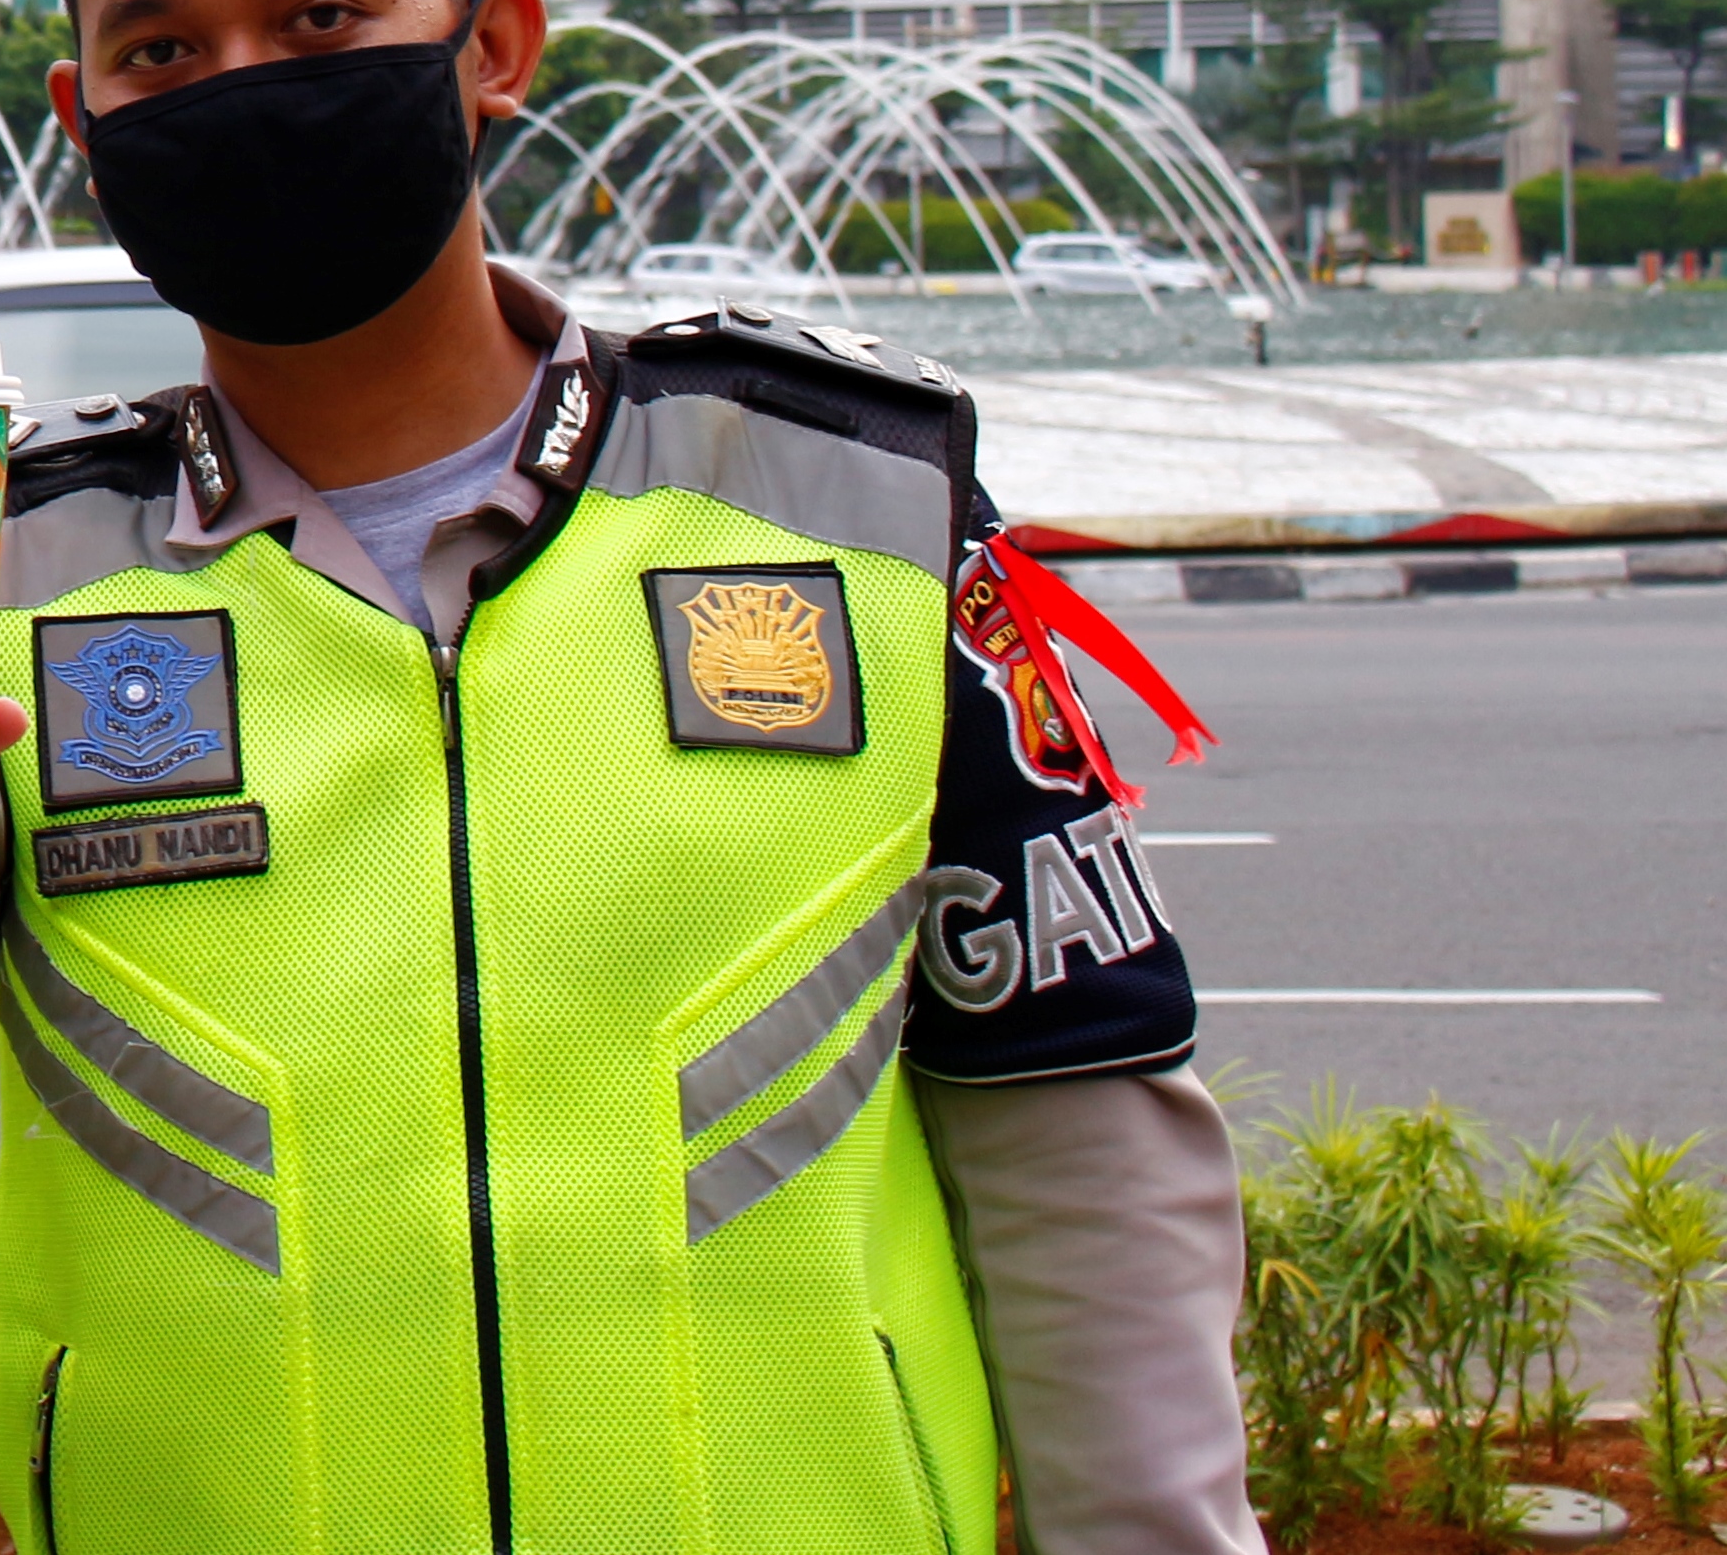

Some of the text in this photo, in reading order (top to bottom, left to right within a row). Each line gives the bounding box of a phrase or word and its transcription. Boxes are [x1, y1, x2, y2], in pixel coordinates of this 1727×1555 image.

[959, 580, 994, 626] PO
[47, 820, 251, 878] DHANU NANDI
[918, 802, 1173, 1013] GAT
